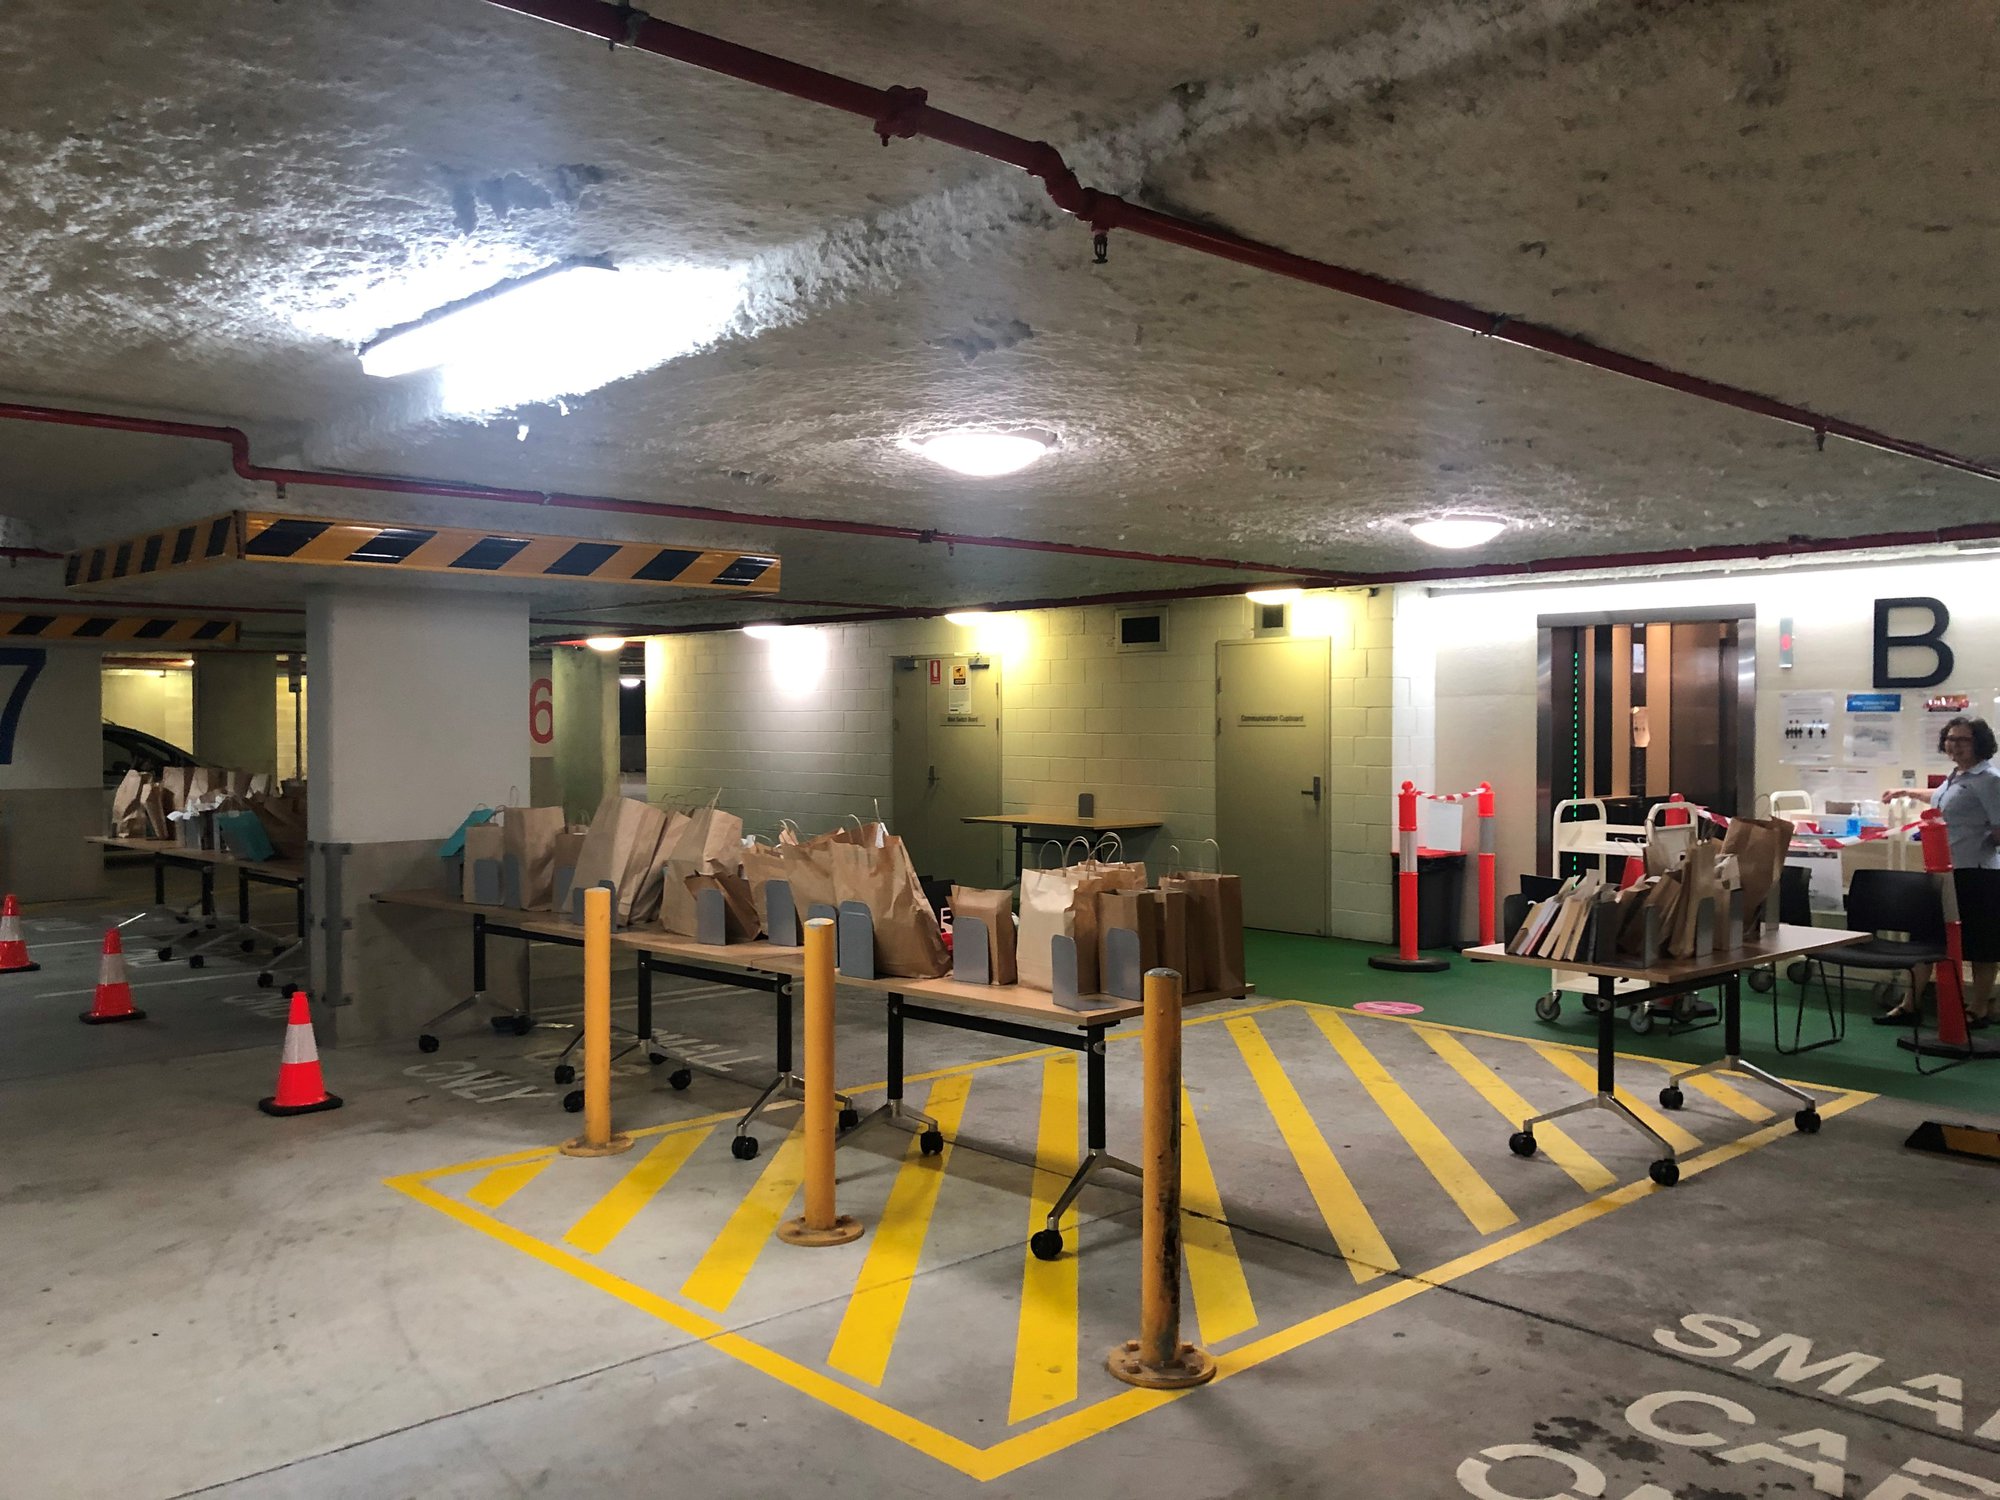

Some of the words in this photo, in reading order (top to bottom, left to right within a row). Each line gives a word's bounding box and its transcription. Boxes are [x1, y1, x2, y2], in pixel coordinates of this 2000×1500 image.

[1873, 597, 1954, 688] B
[0, 647, 46, 764] 7
[529, 678, 553, 744] 6
[1240, 714, 1278, 722] Communication
[1279, 714, 1304, 722] Cupboard
